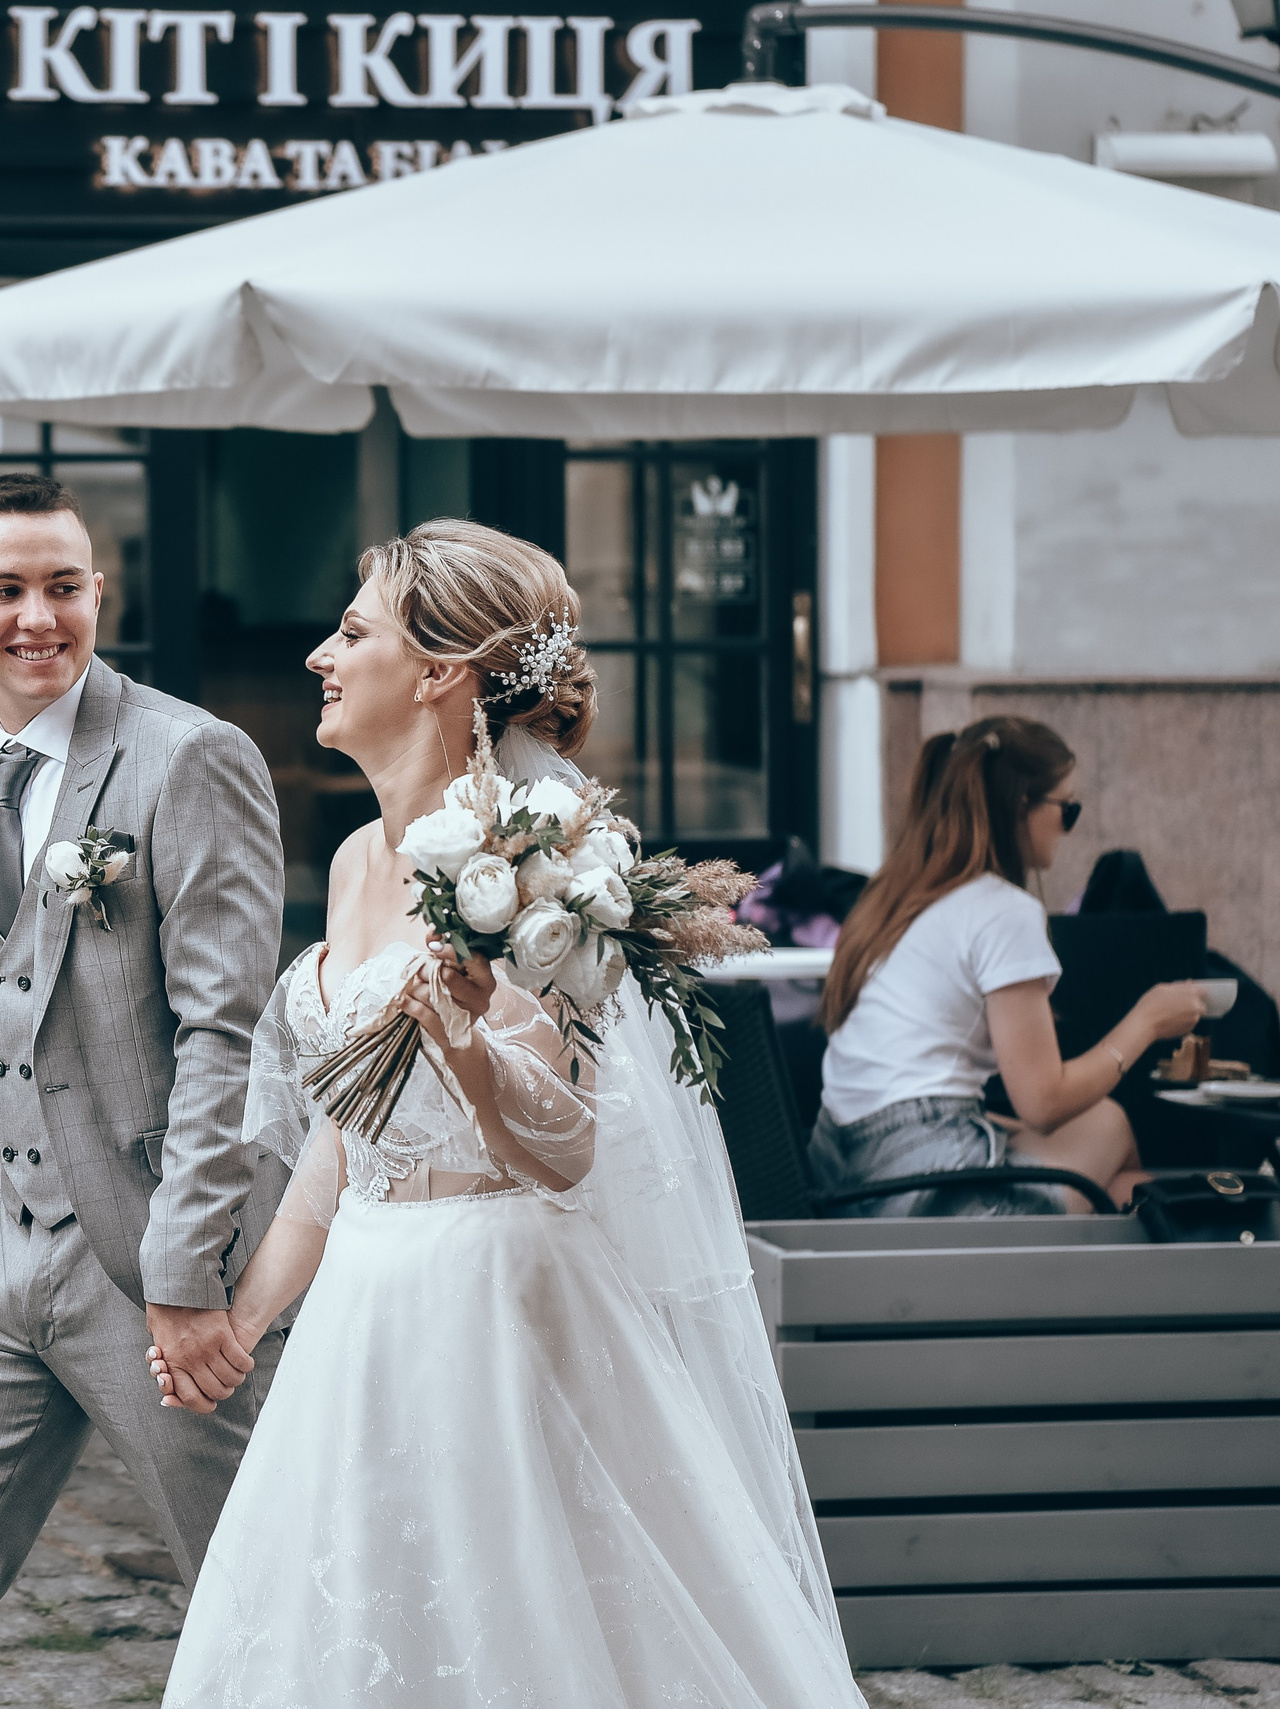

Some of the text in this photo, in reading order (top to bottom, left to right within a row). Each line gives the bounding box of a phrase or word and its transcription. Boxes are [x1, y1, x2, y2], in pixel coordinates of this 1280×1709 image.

[7, 5, 702, 124] КІТ І КИЦЯ
[101, 135, 283, 189] КАВА
[283, 139, 369, 190] ТА
